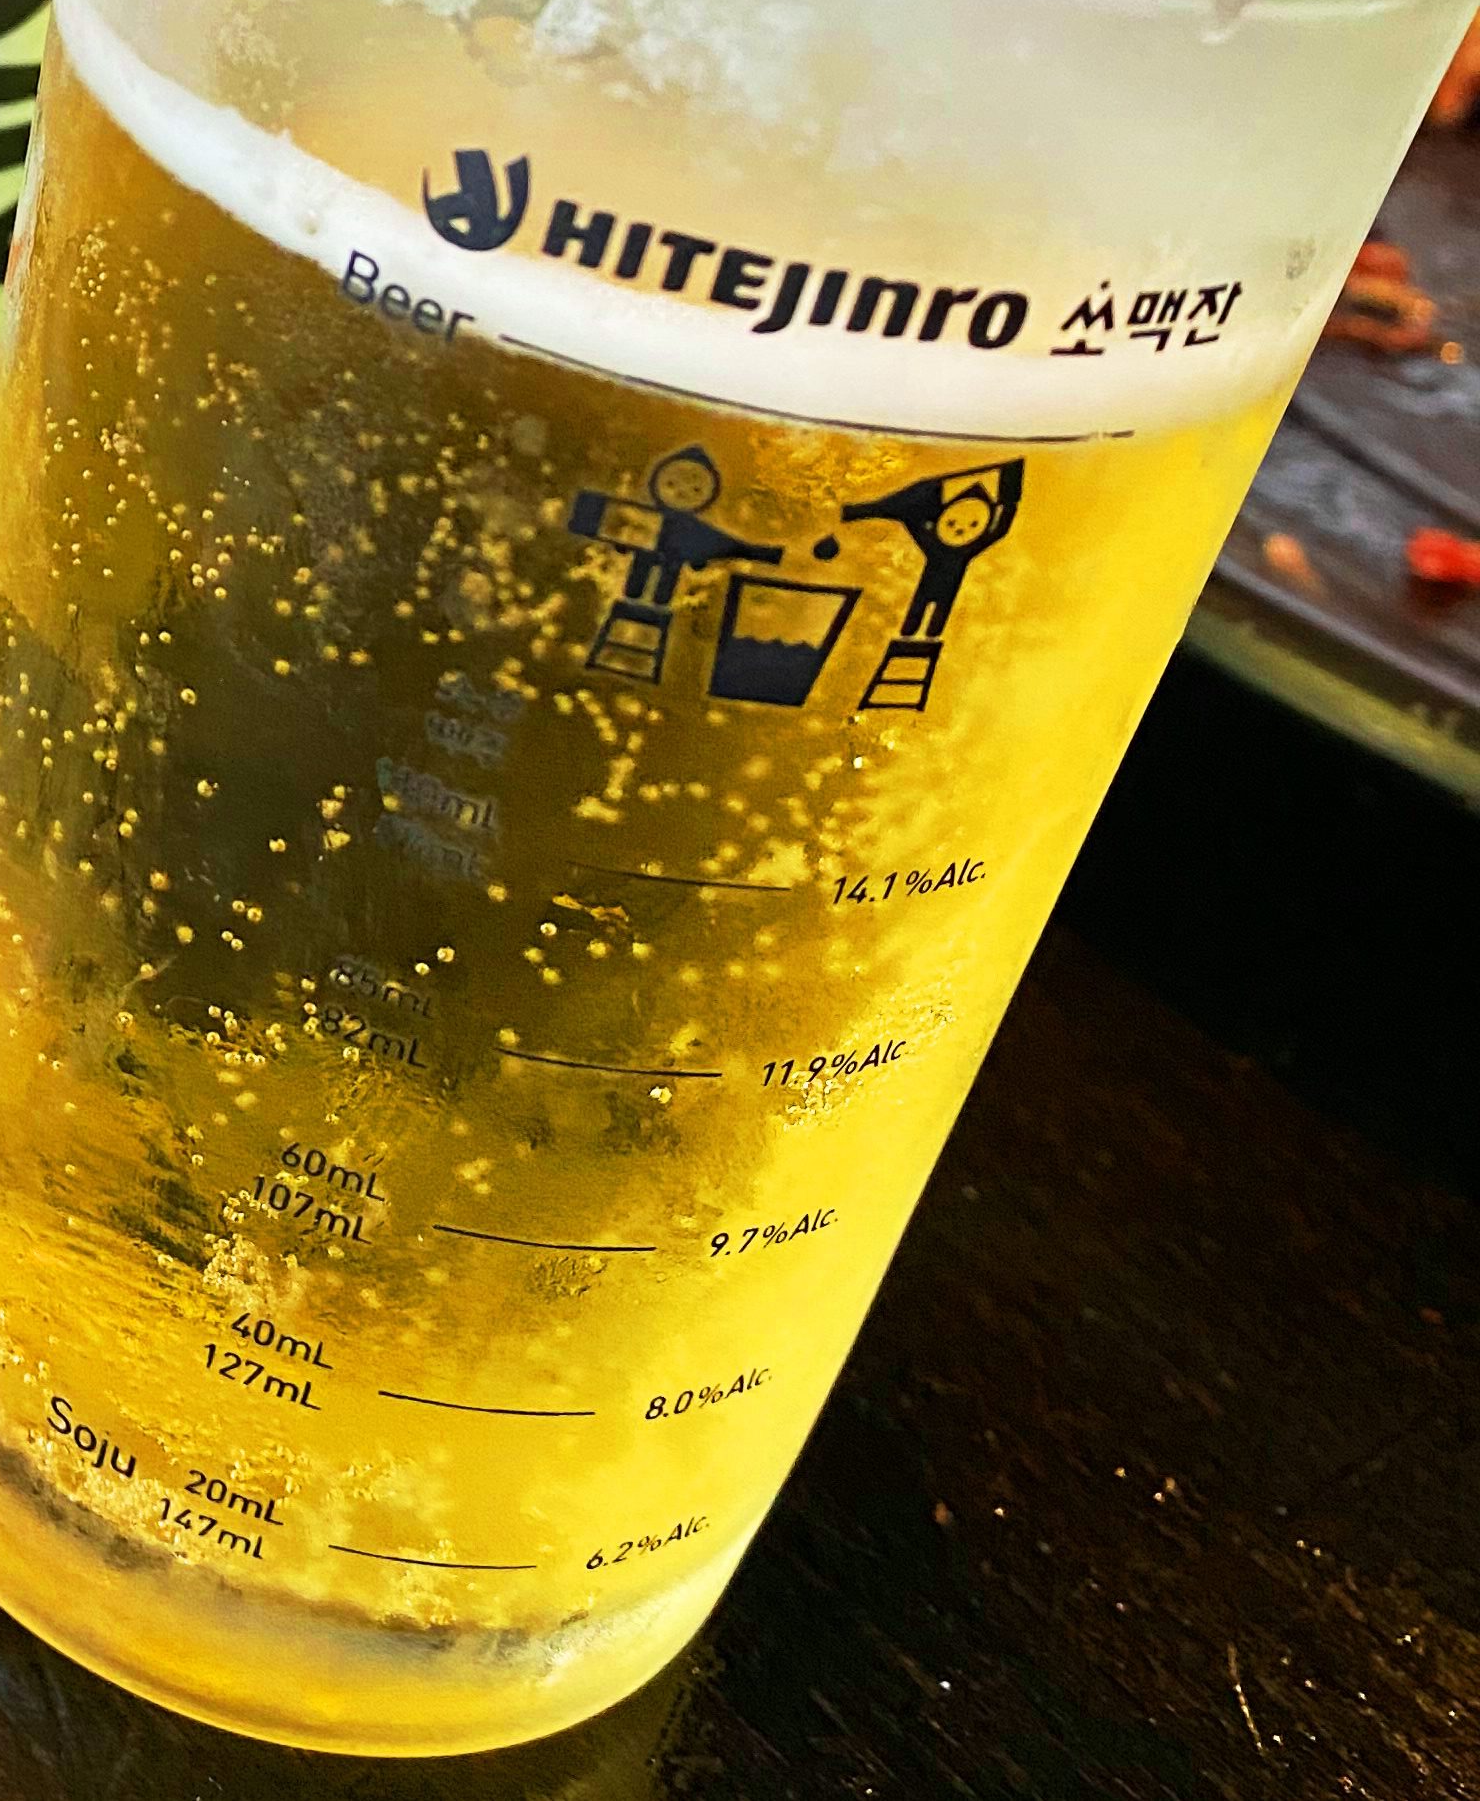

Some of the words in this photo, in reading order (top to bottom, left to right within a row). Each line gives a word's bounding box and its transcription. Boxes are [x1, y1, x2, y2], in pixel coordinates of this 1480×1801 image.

[343, 250, 477, 343] Beer
[281, 1141, 386, 1202] 60mL
[254, 1175, 373, 1245] 107mL
[231, 1312, 334, 1370] 40mL
[204, 1343, 322, 1411] 127mL
[46, 1396, 137, 1478] Soju
[160, 1497, 264, 1560] 147mL
[184, 1469, 284, 1526] 20mL
